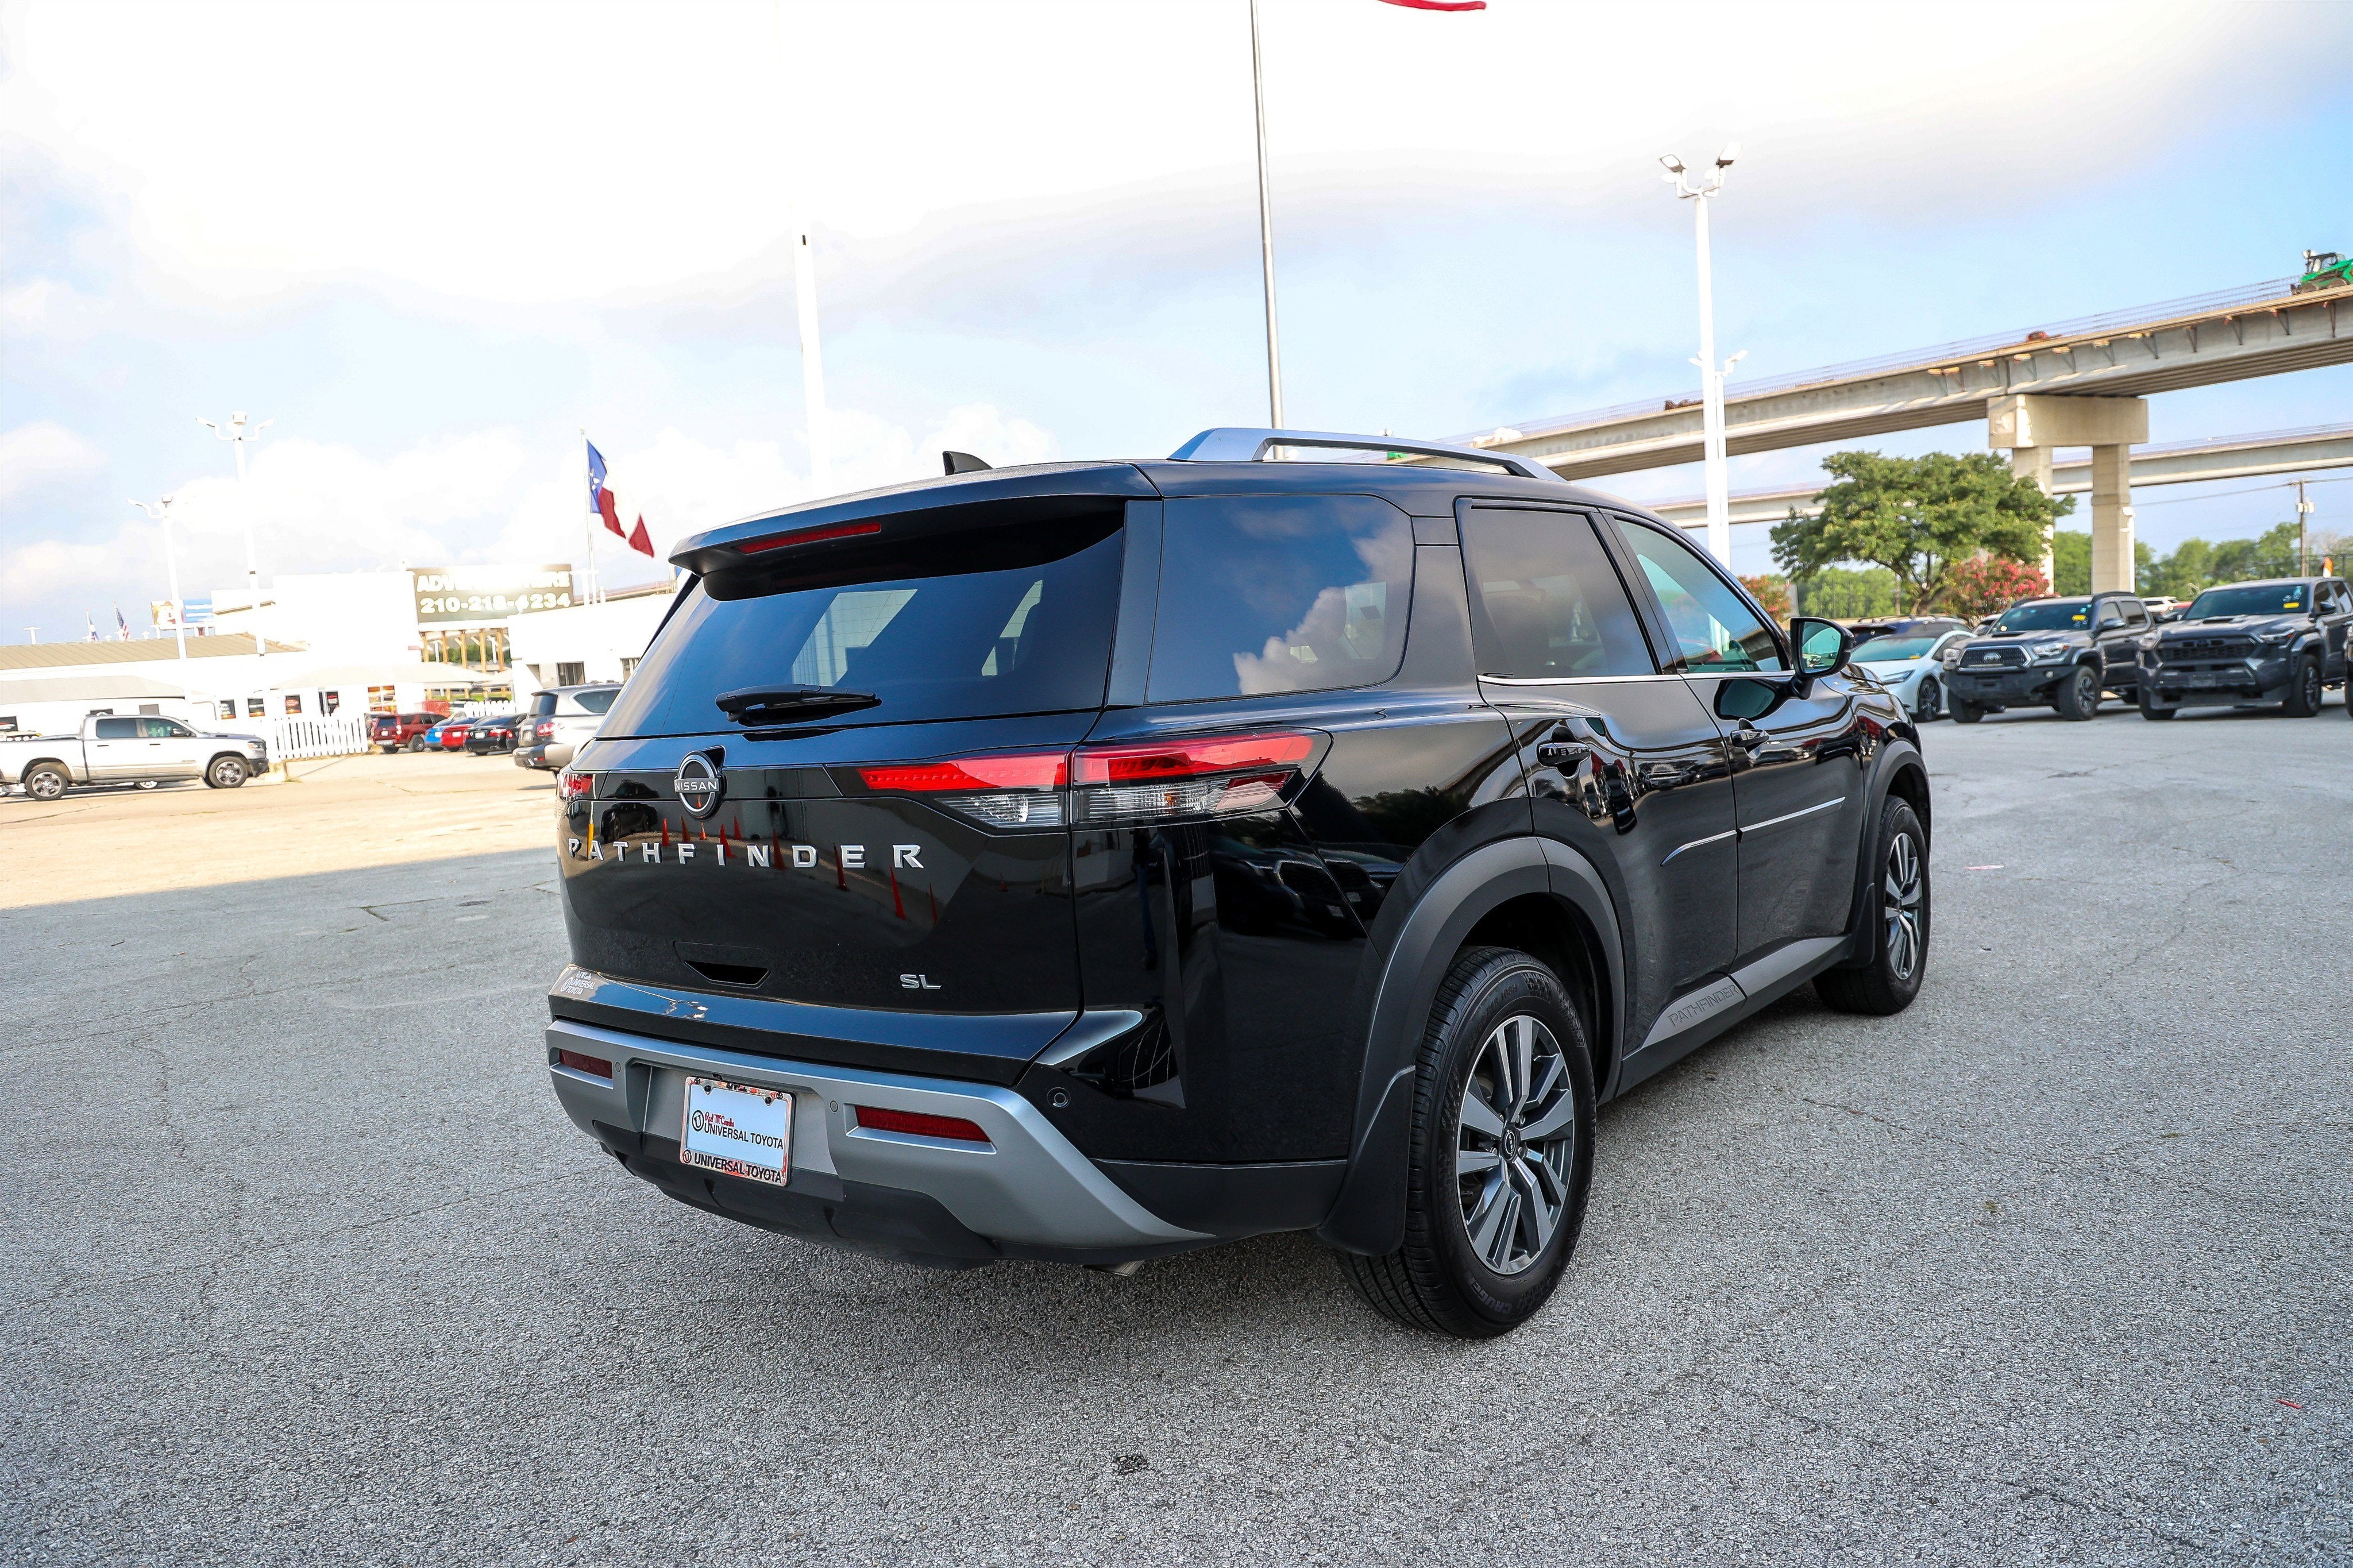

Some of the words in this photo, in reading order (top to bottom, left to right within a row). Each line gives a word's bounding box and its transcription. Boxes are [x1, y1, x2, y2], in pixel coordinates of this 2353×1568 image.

[420, 592, 571, 613] 210-218-4234
[674, 781, 717, 790] NISSAN
[568, 838, 924, 869] PATHFINDER
[566, 986, 584, 995] TOYOTA
[571, 979, 595, 989] UNIVERSAL
[900, 974, 942, 989] SL
[1667, 984, 1739, 1027] PATHFINDER
[704, 1111, 714, 1124] Red
[704, 1122, 749, 1142] UNIVERSAL
[750, 1132, 784, 1150] TOYOTA
[694, 1152, 745, 1175] UNIVERSAL
[746, 1164, 783, 1184] TOYOTA
